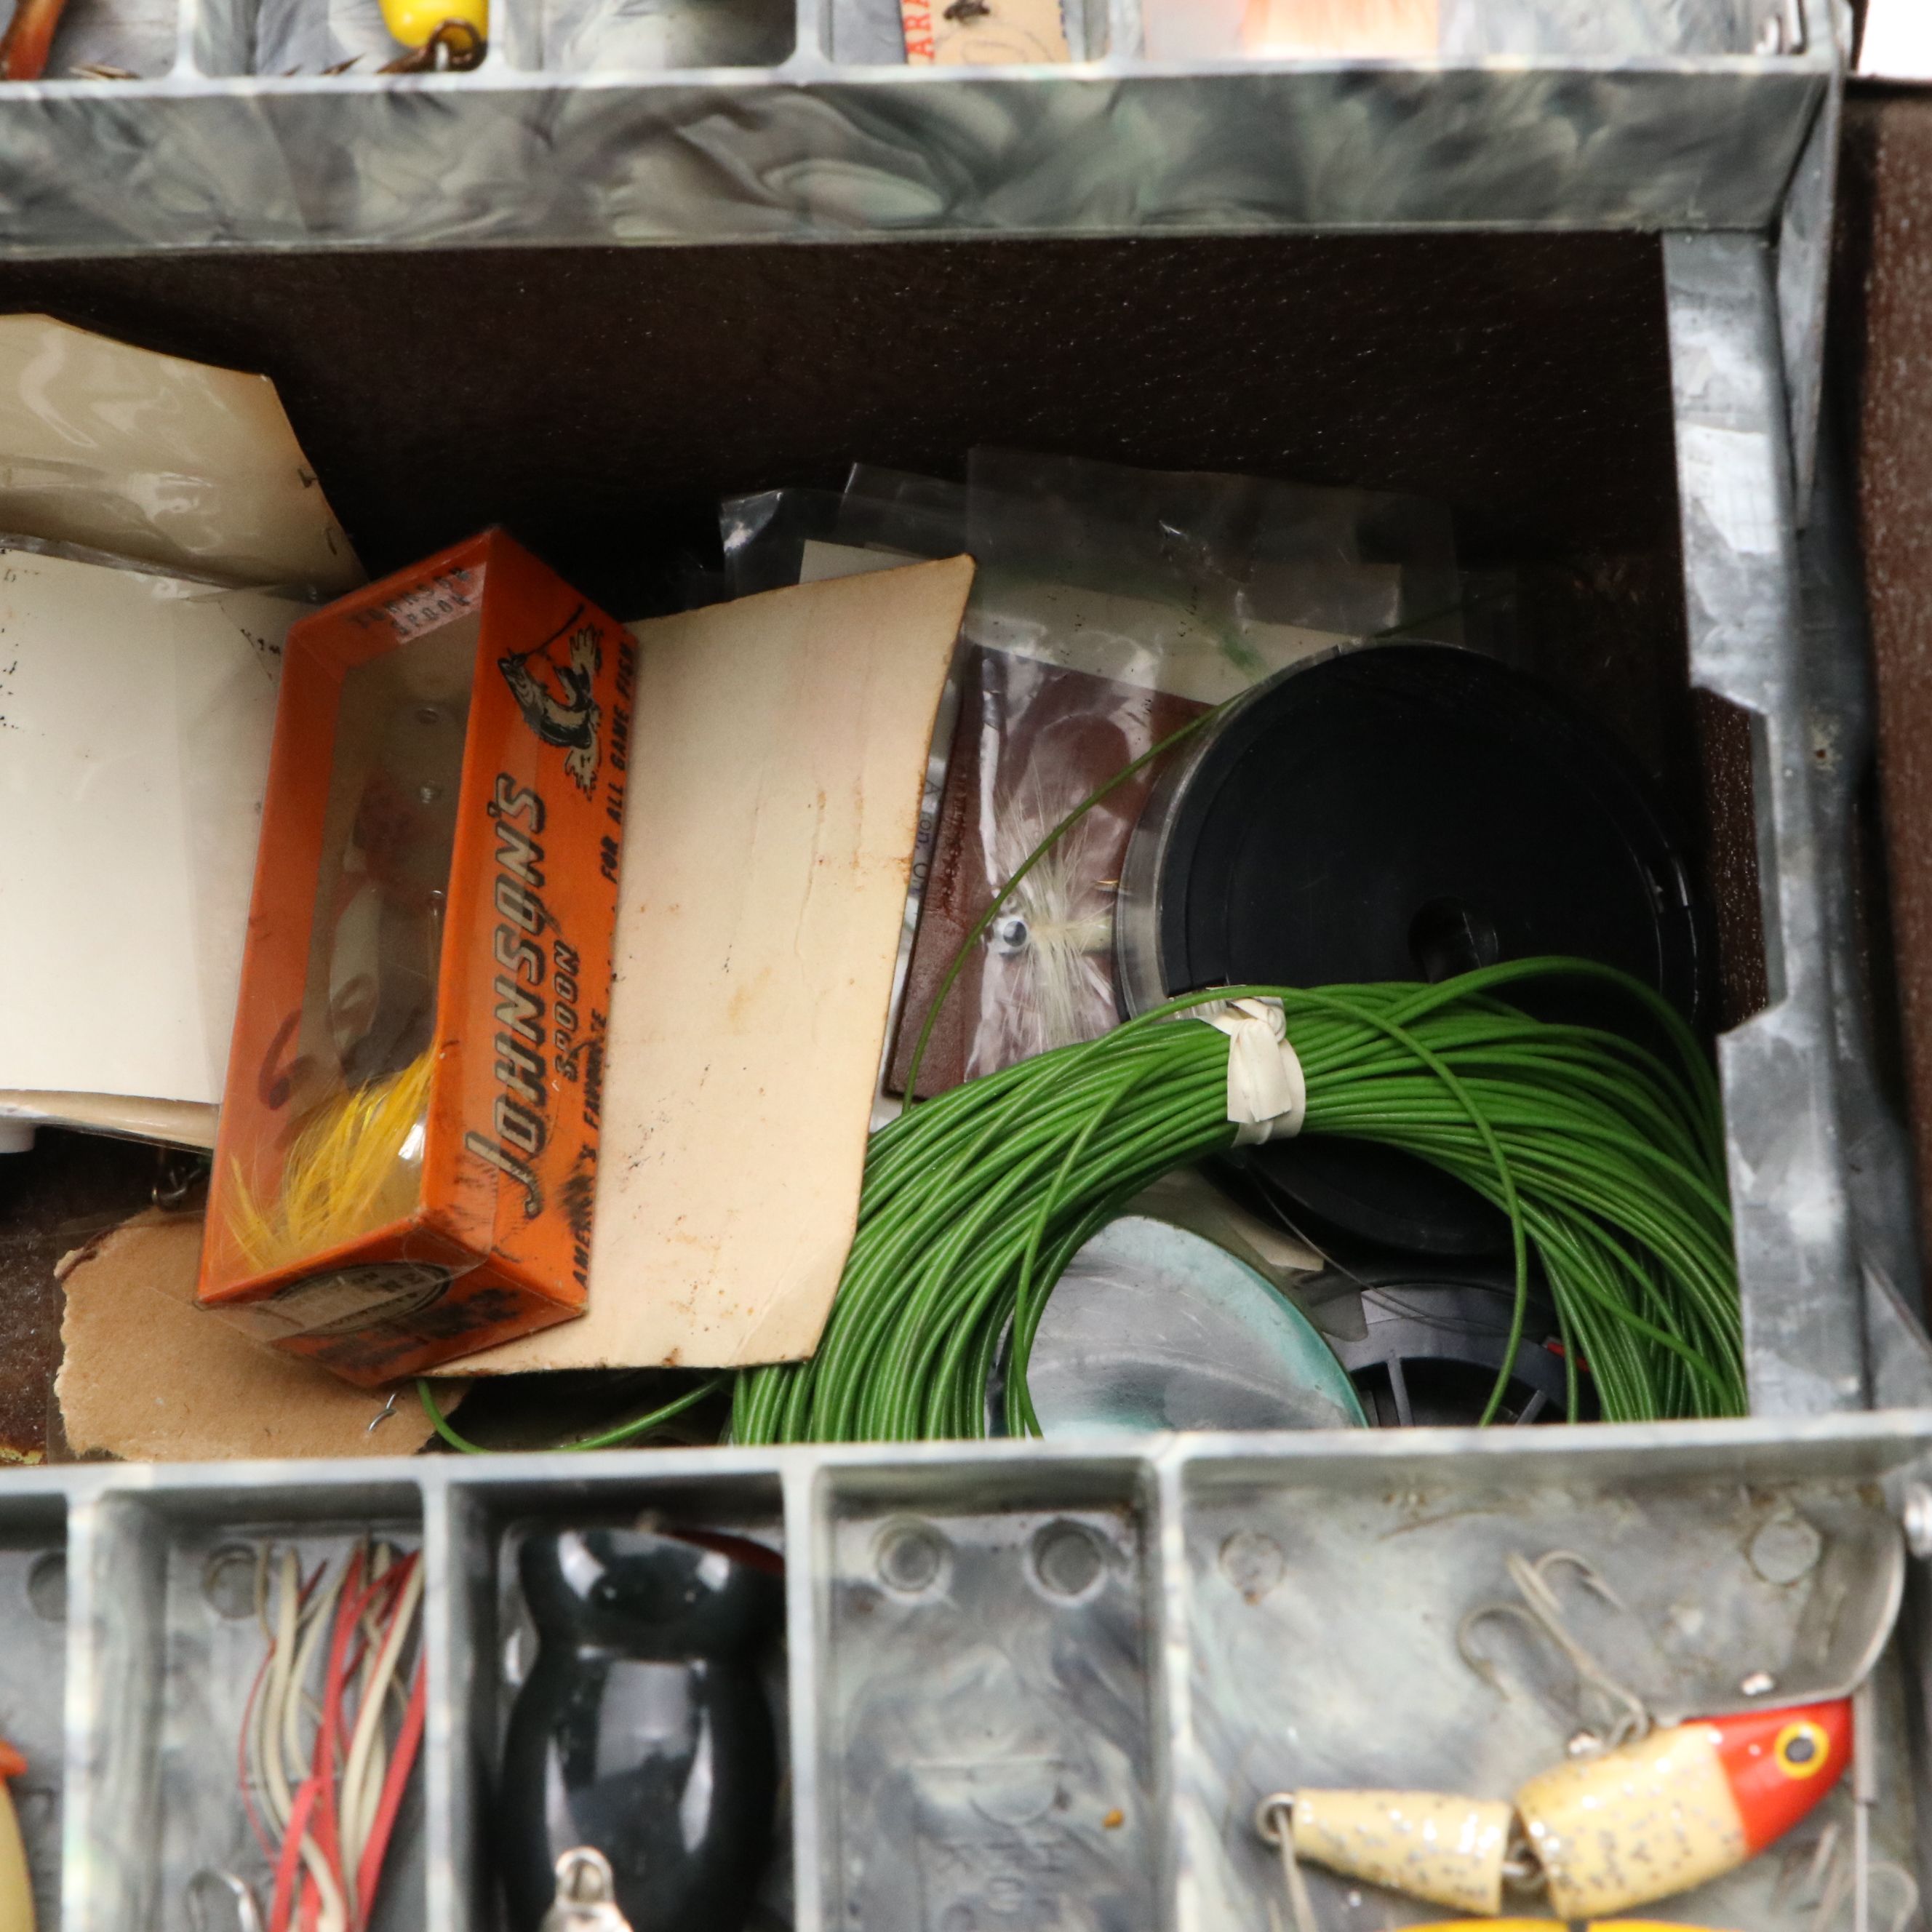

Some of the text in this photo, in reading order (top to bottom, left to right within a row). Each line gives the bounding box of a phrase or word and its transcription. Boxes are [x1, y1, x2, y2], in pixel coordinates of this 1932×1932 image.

[391, 592, 471, 636] SPOON
[600, 642, 638, 885] FOR ALL GAME FISH
[463, 773, 548, 1221] JOHNSON'S
[553, 939, 580, 1083] SPOON
